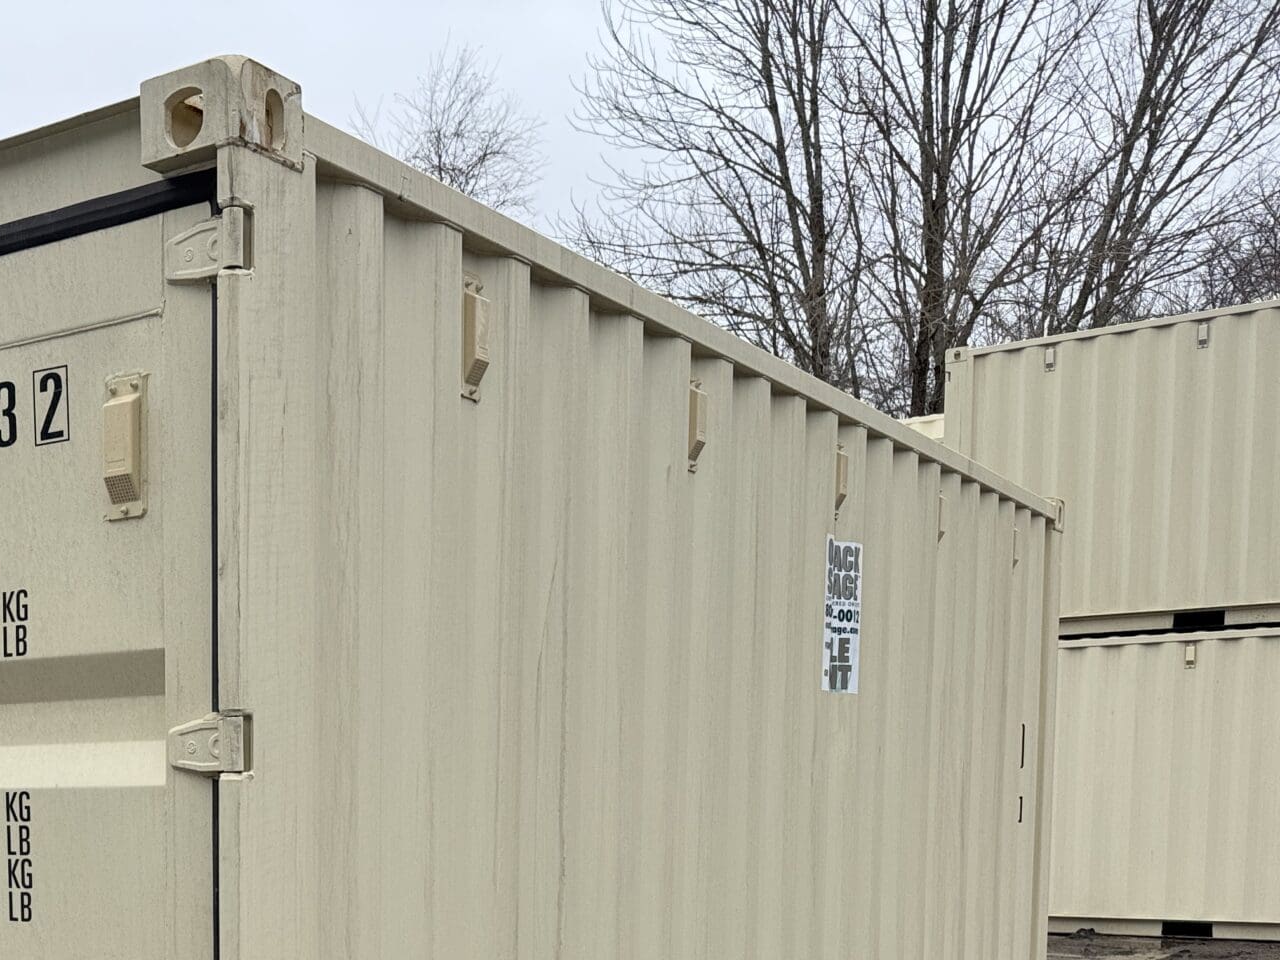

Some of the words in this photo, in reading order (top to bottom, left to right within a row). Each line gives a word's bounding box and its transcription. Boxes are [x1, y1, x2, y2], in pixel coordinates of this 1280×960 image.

[38, 371, 64, 441] 2
[2, 589, 29, 623] KG
[2, 624, 28, 658] LB
[5, 791, 31, 823] KG
[6, 825, 31, 856] LB
[7, 858, 33, 889] KG
[8, 892, 33, 922] LB
